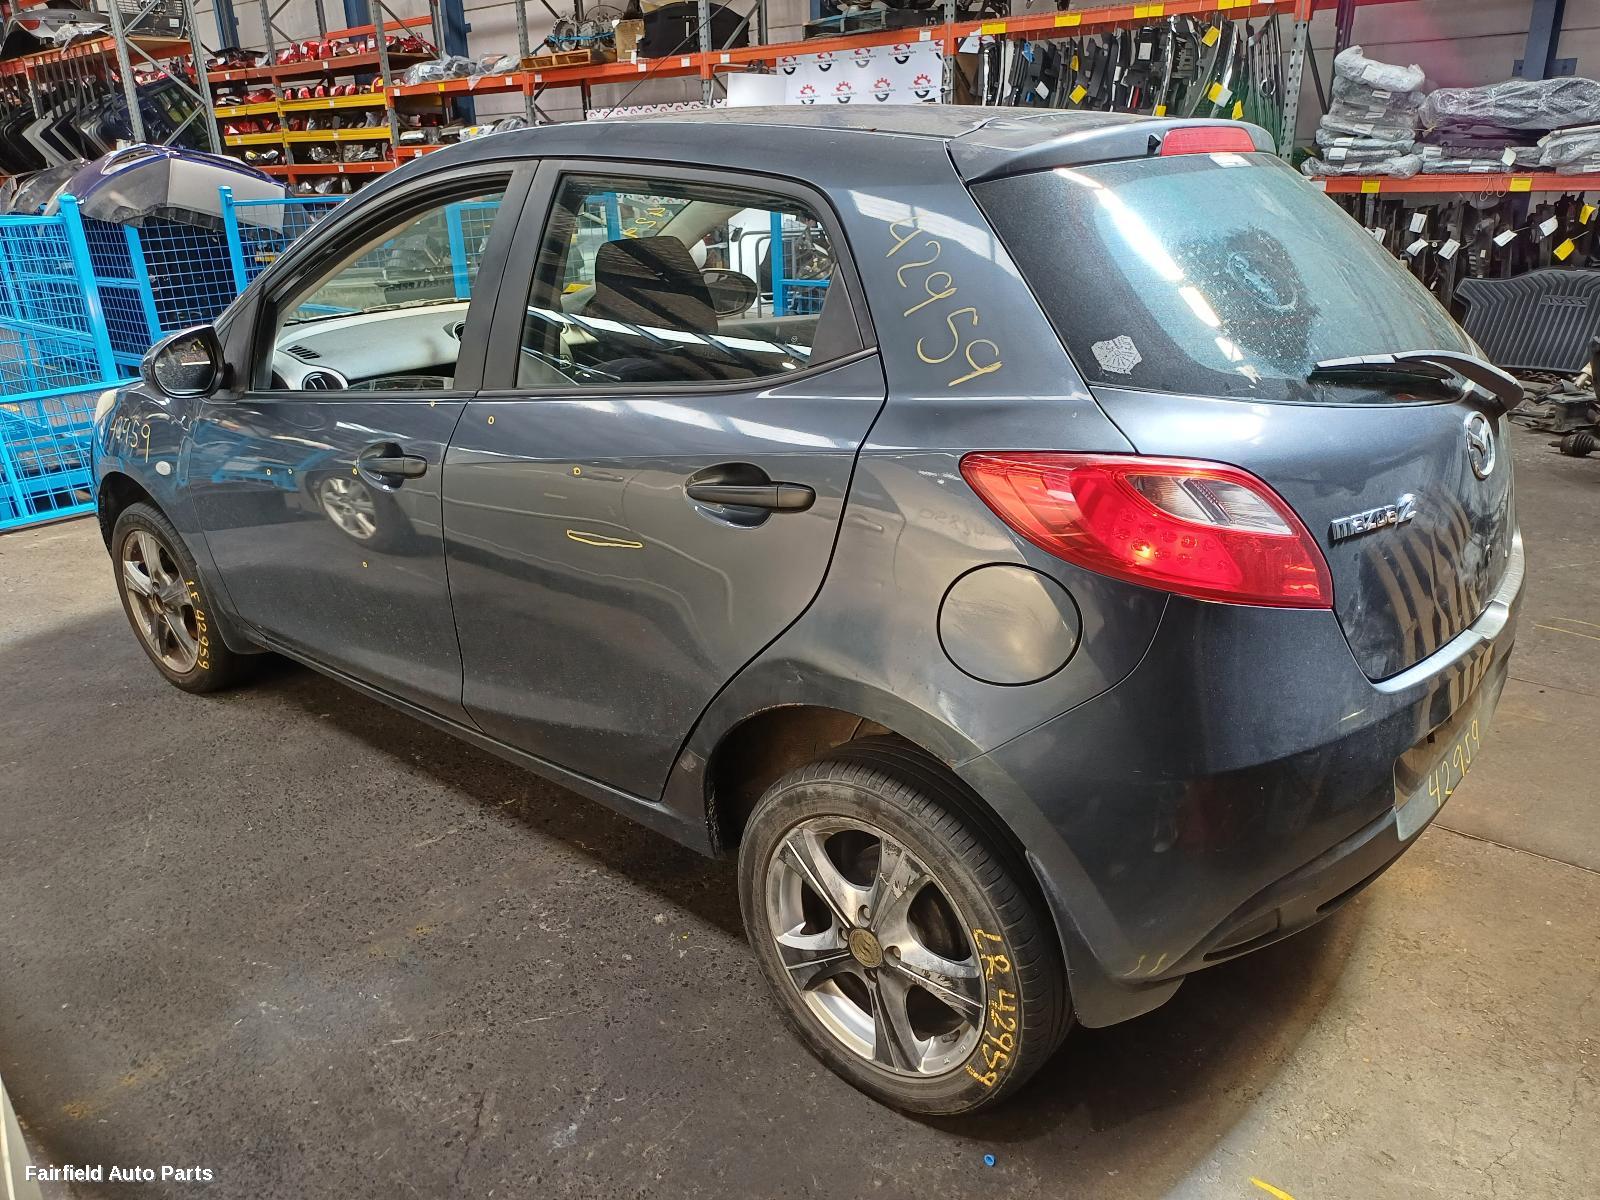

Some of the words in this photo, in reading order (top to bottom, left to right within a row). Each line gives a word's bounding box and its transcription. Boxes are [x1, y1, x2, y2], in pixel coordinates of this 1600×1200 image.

[885, 215, 1003, 387] 42959
[1428, 719, 1481, 807] 42959
[973, 928, 1012, 981] LR
